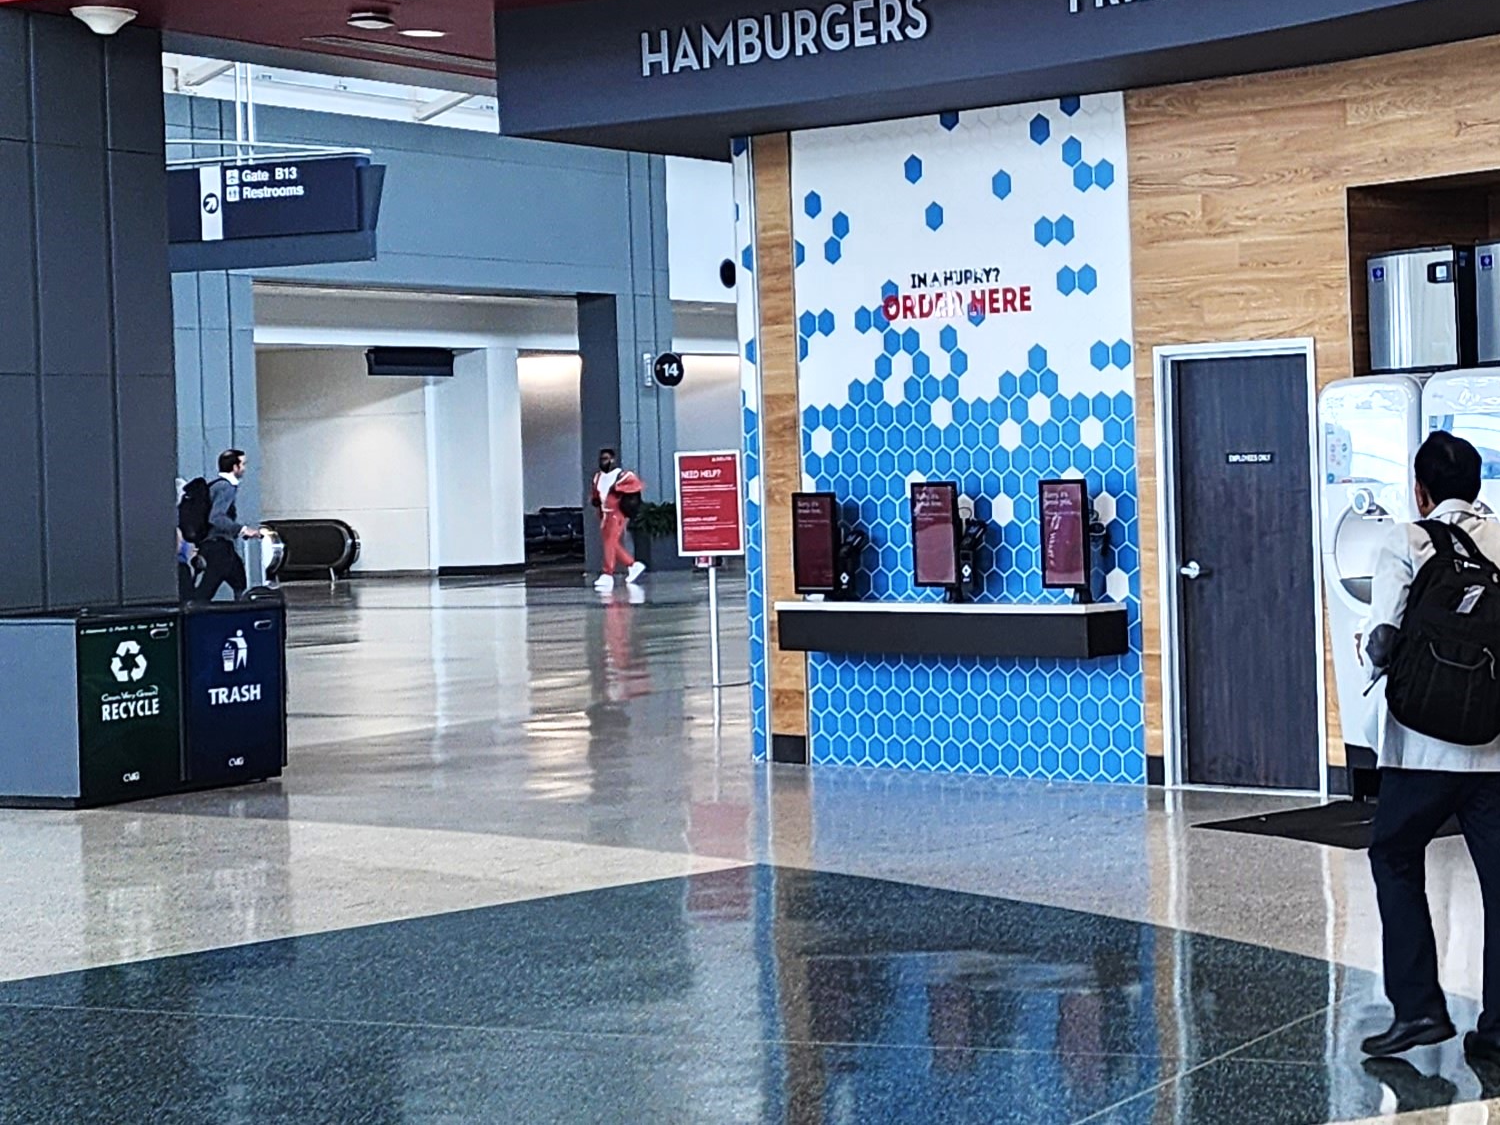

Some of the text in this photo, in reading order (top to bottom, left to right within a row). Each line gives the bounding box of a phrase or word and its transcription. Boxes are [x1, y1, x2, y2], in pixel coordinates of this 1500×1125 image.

[241, 166, 298, 183] Gate B13
[242, 185, 305, 200] Restrooms
[911, 273, 927, 289] IN
[969, 286, 1032, 316] HERE
[662, 362, 680, 377] 14
[681, 469, 722, 479] NEED HELP?
[208, 684, 262, 705] TRASH
[101, 698, 160, 722] RECYCLE
